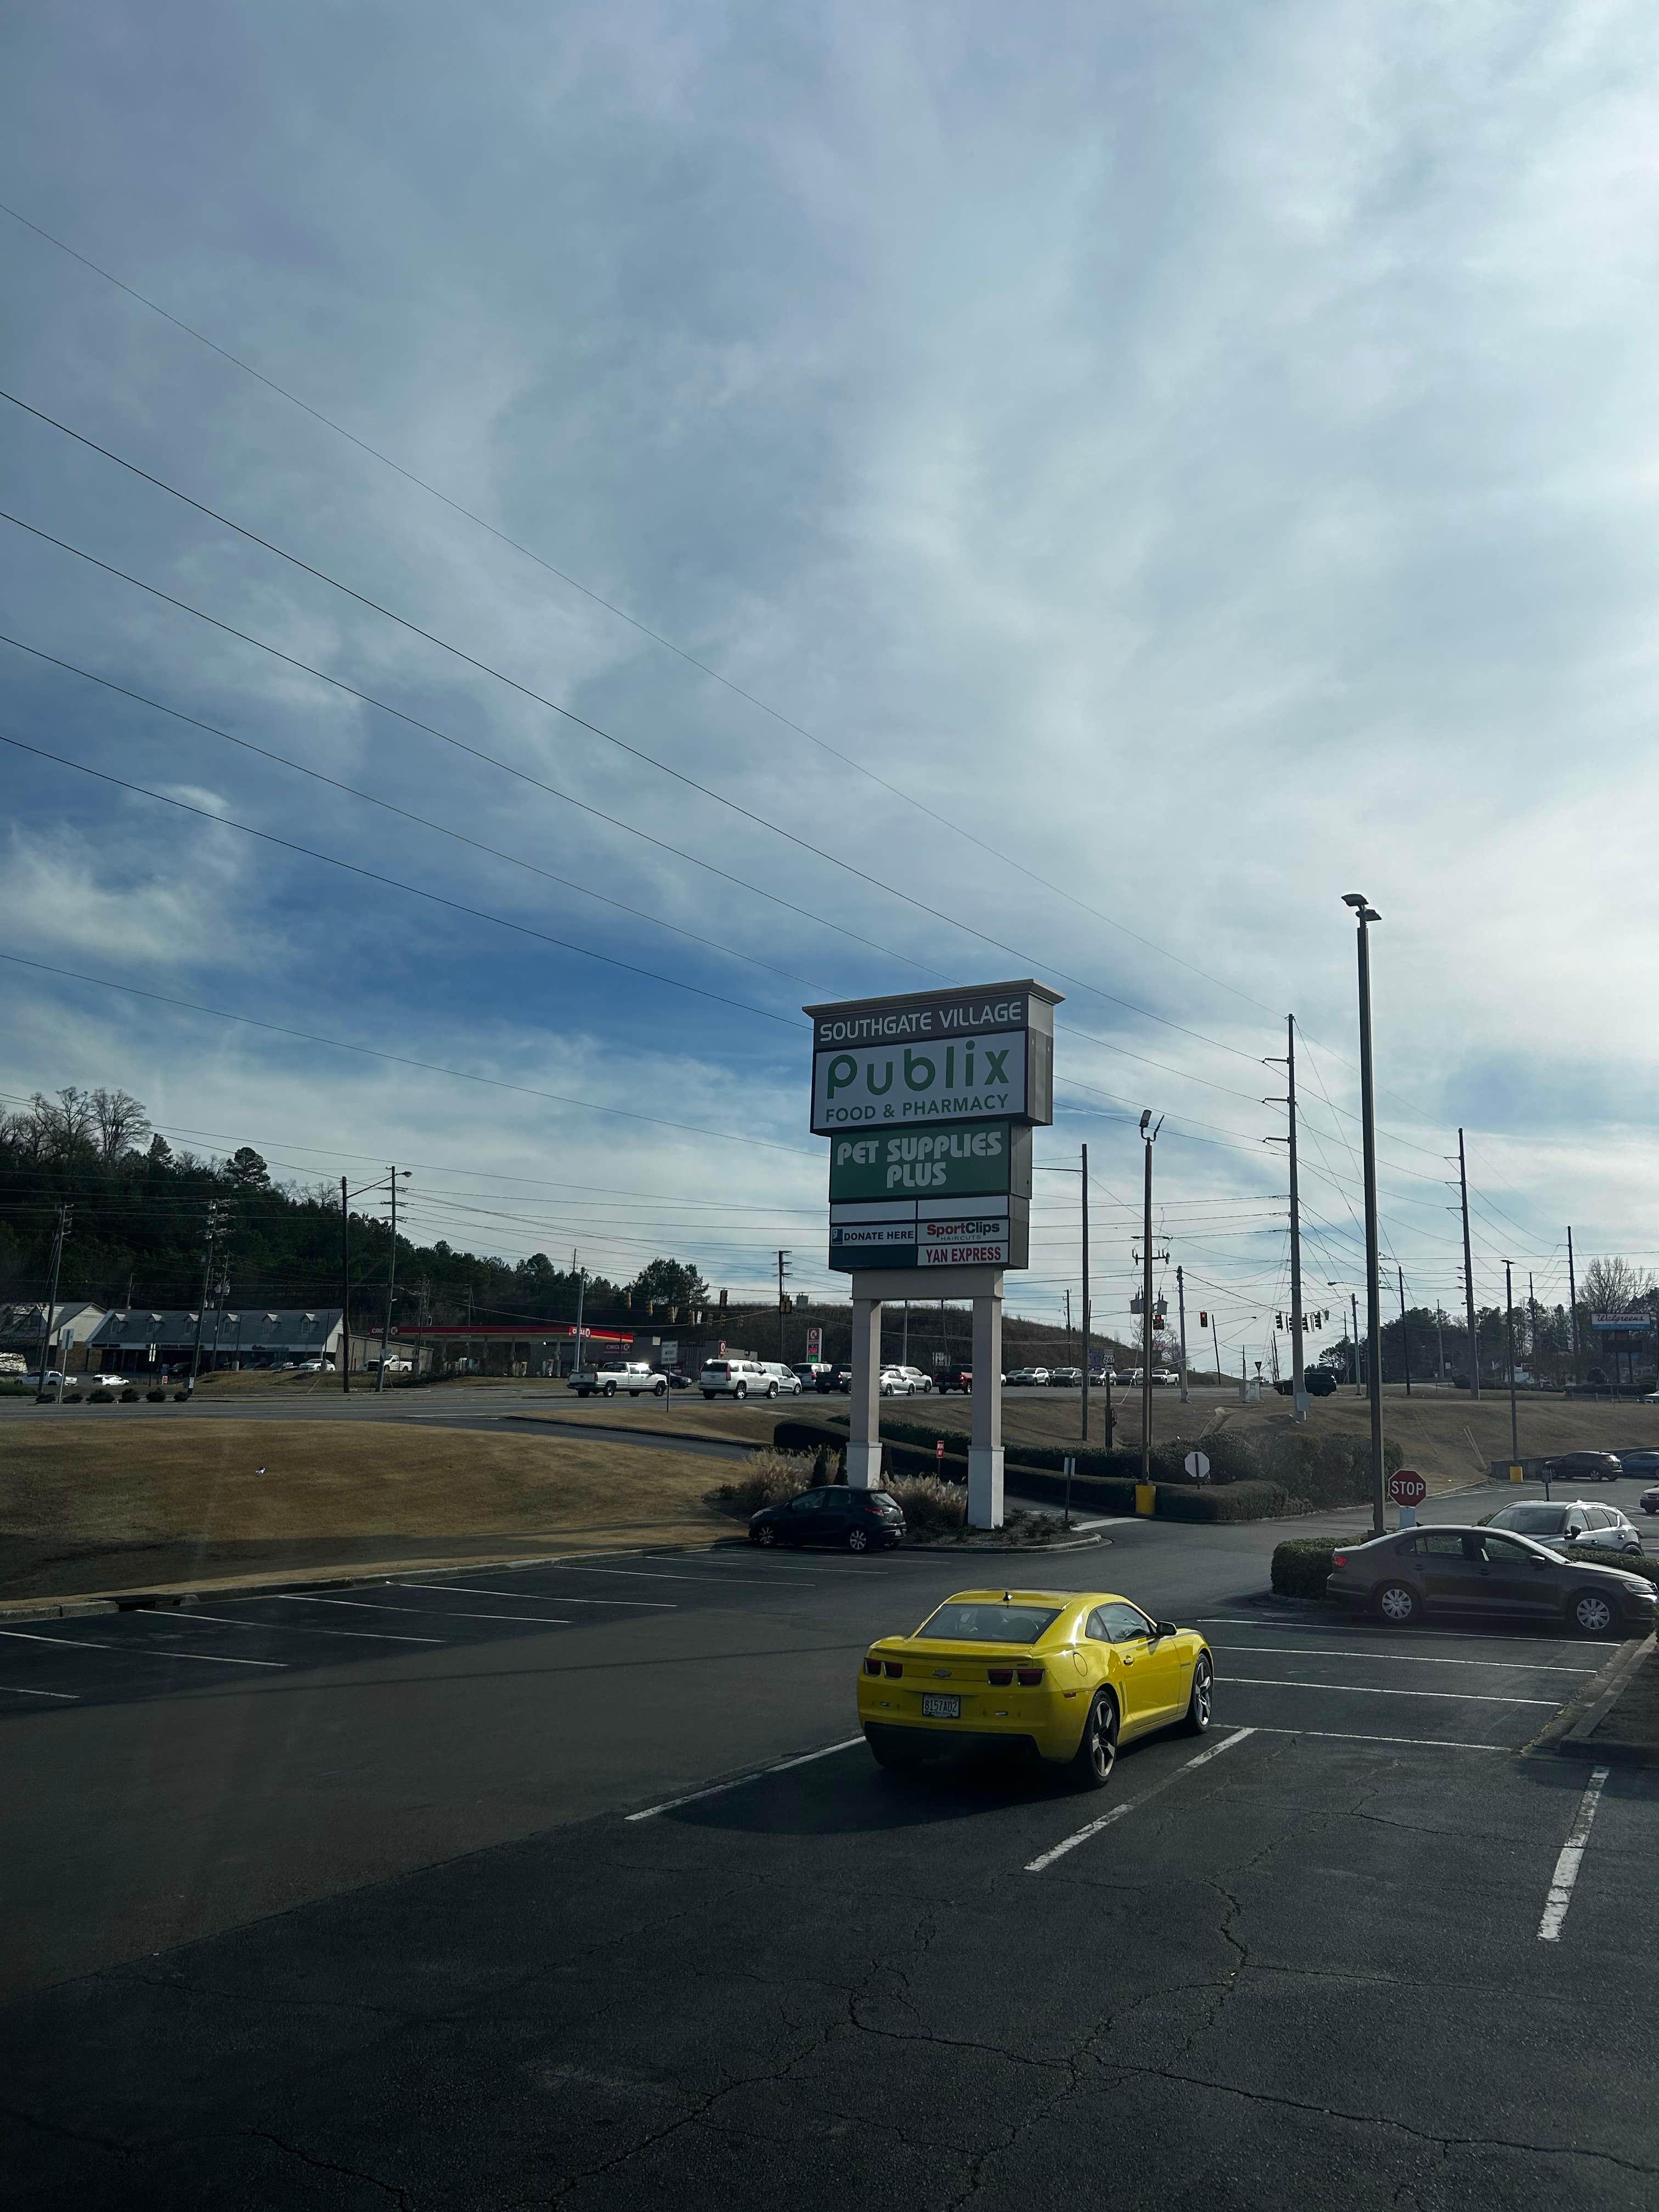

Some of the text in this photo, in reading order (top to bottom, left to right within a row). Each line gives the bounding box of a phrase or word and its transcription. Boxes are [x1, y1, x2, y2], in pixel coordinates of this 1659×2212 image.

[820, 1001, 1022, 1041] SOUTHGATE VILLAGE
[826, 1040, 1010, 1099] Publix
[826, 1093, 1009, 1122] FOOD & PHARMACY
[837, 1131, 1002, 1166] PET SUPPLIES
[886, 1161, 947, 1189] PLUS
[844, 1231, 914, 1241] DONATE HERE
[926, 1246, 1001, 1263] YAN EXPRESS
[1596, 1314, 1645, 1324] Walgreens
[1391, 1480, 1424, 1496] STOP
